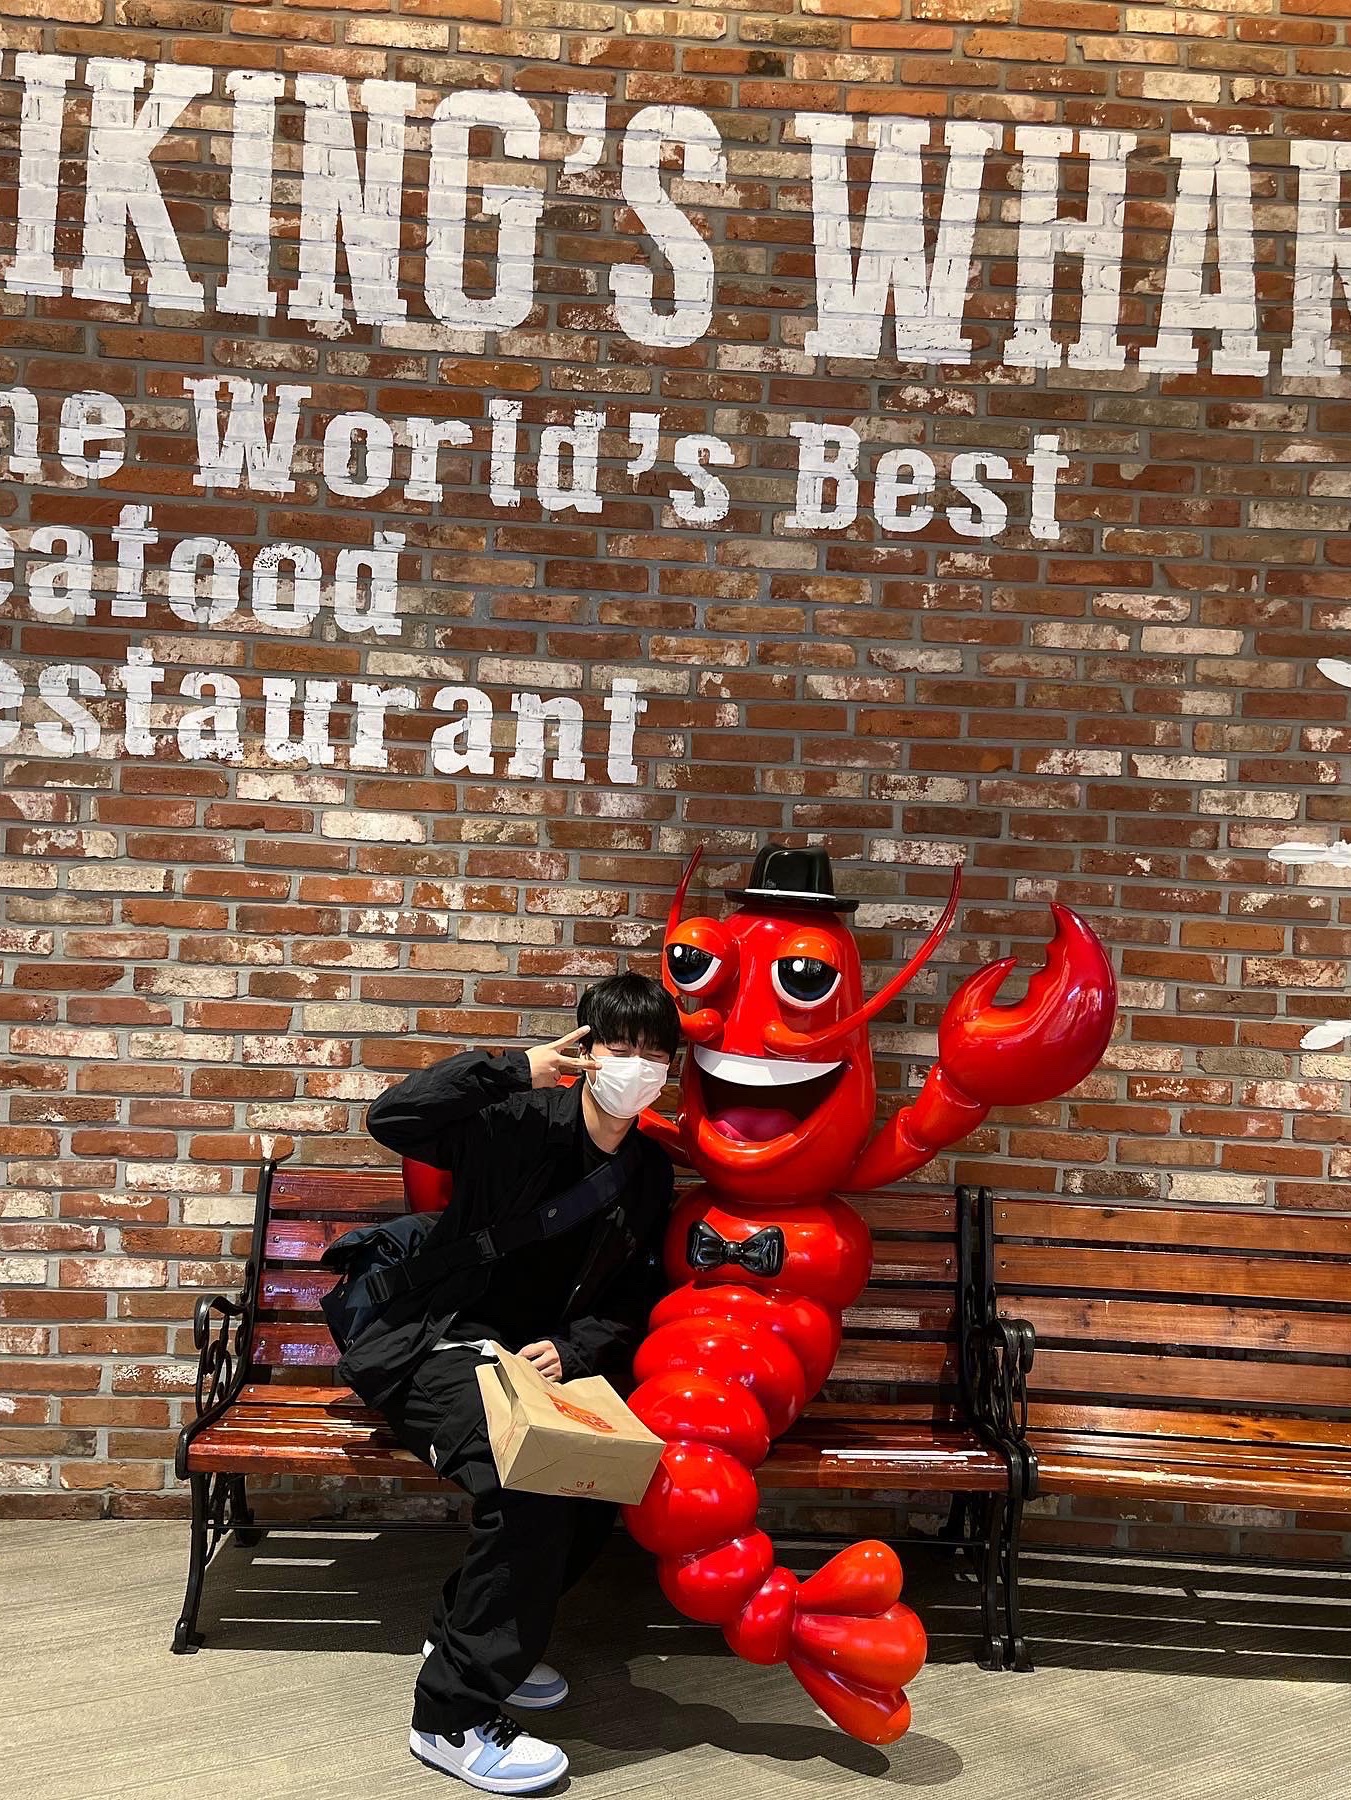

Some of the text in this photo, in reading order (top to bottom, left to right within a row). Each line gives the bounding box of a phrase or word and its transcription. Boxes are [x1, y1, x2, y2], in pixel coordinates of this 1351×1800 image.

[0, 53, 727, 348] IKING'S
[183, 374, 737, 524] World's
[784, 420, 1070, 541] Best
[0, 503, 407, 636] afood
